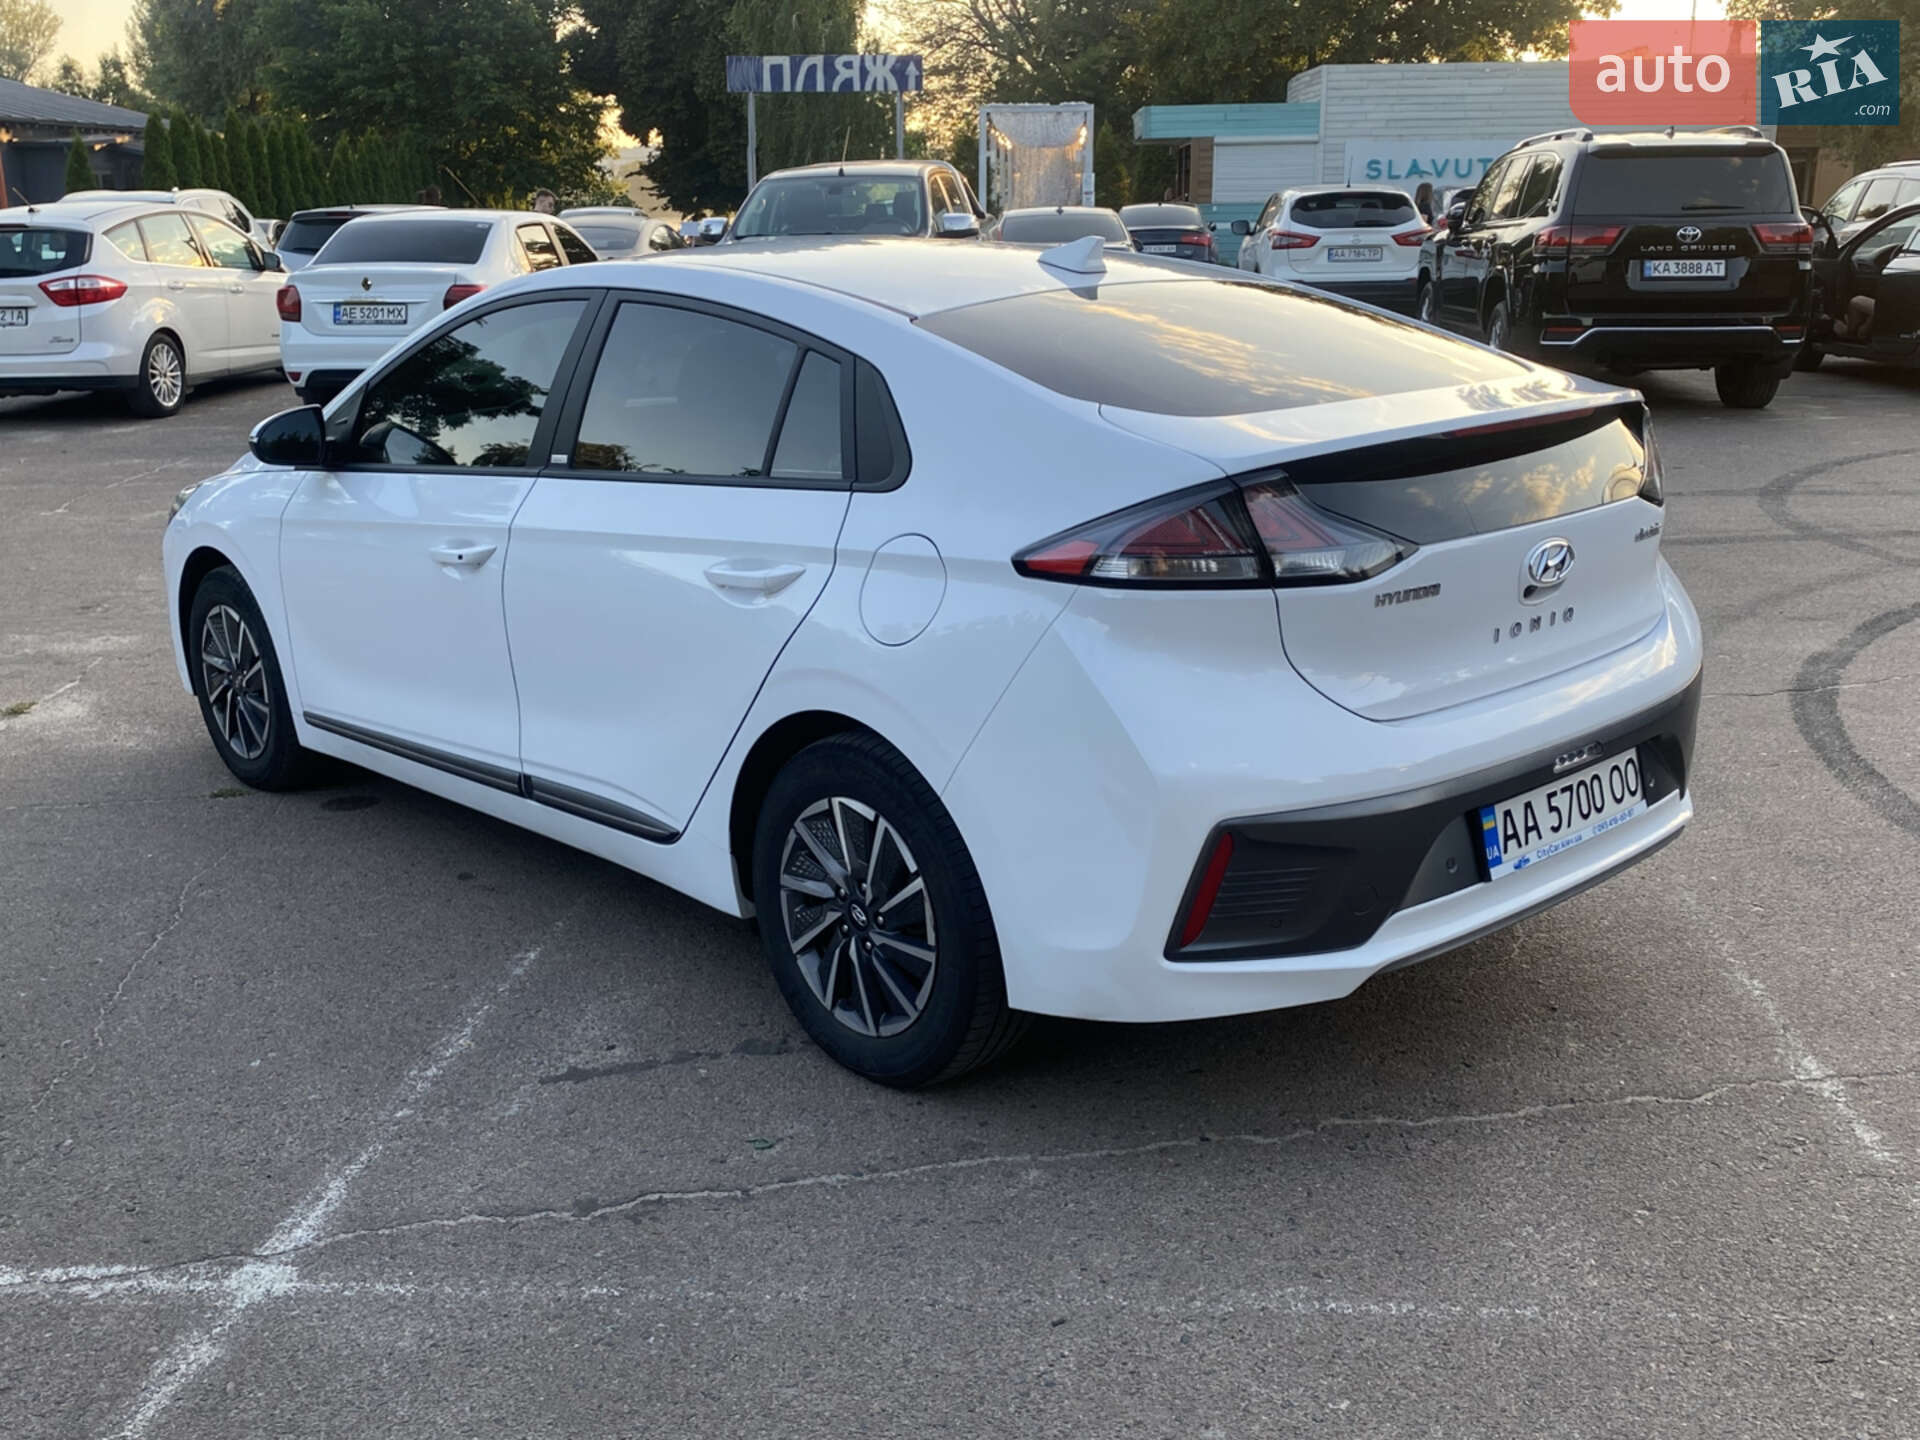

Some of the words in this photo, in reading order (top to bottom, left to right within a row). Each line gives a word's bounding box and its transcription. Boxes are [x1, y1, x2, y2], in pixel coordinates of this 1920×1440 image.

[762, 55, 898, 92] ПЛЯЖ
[1652, 262, 1671, 274] KA
[1674, 262, 1702, 274] 3888
[1705, 262, 1723, 274] AT
[342, 307, 357, 319] AE
[360, 307, 385, 319] 5201
[387, 307, 404, 319] MX
[1374, 583, 1441, 608] HYUNDAI
[1493, 607, 1574, 644] IONIQ
[1502, 801, 1542, 855] AA
[1546, 773, 1604, 834] 5700
[1609, 757, 1639, 804] OO
[1486, 846, 1500, 860] UA
